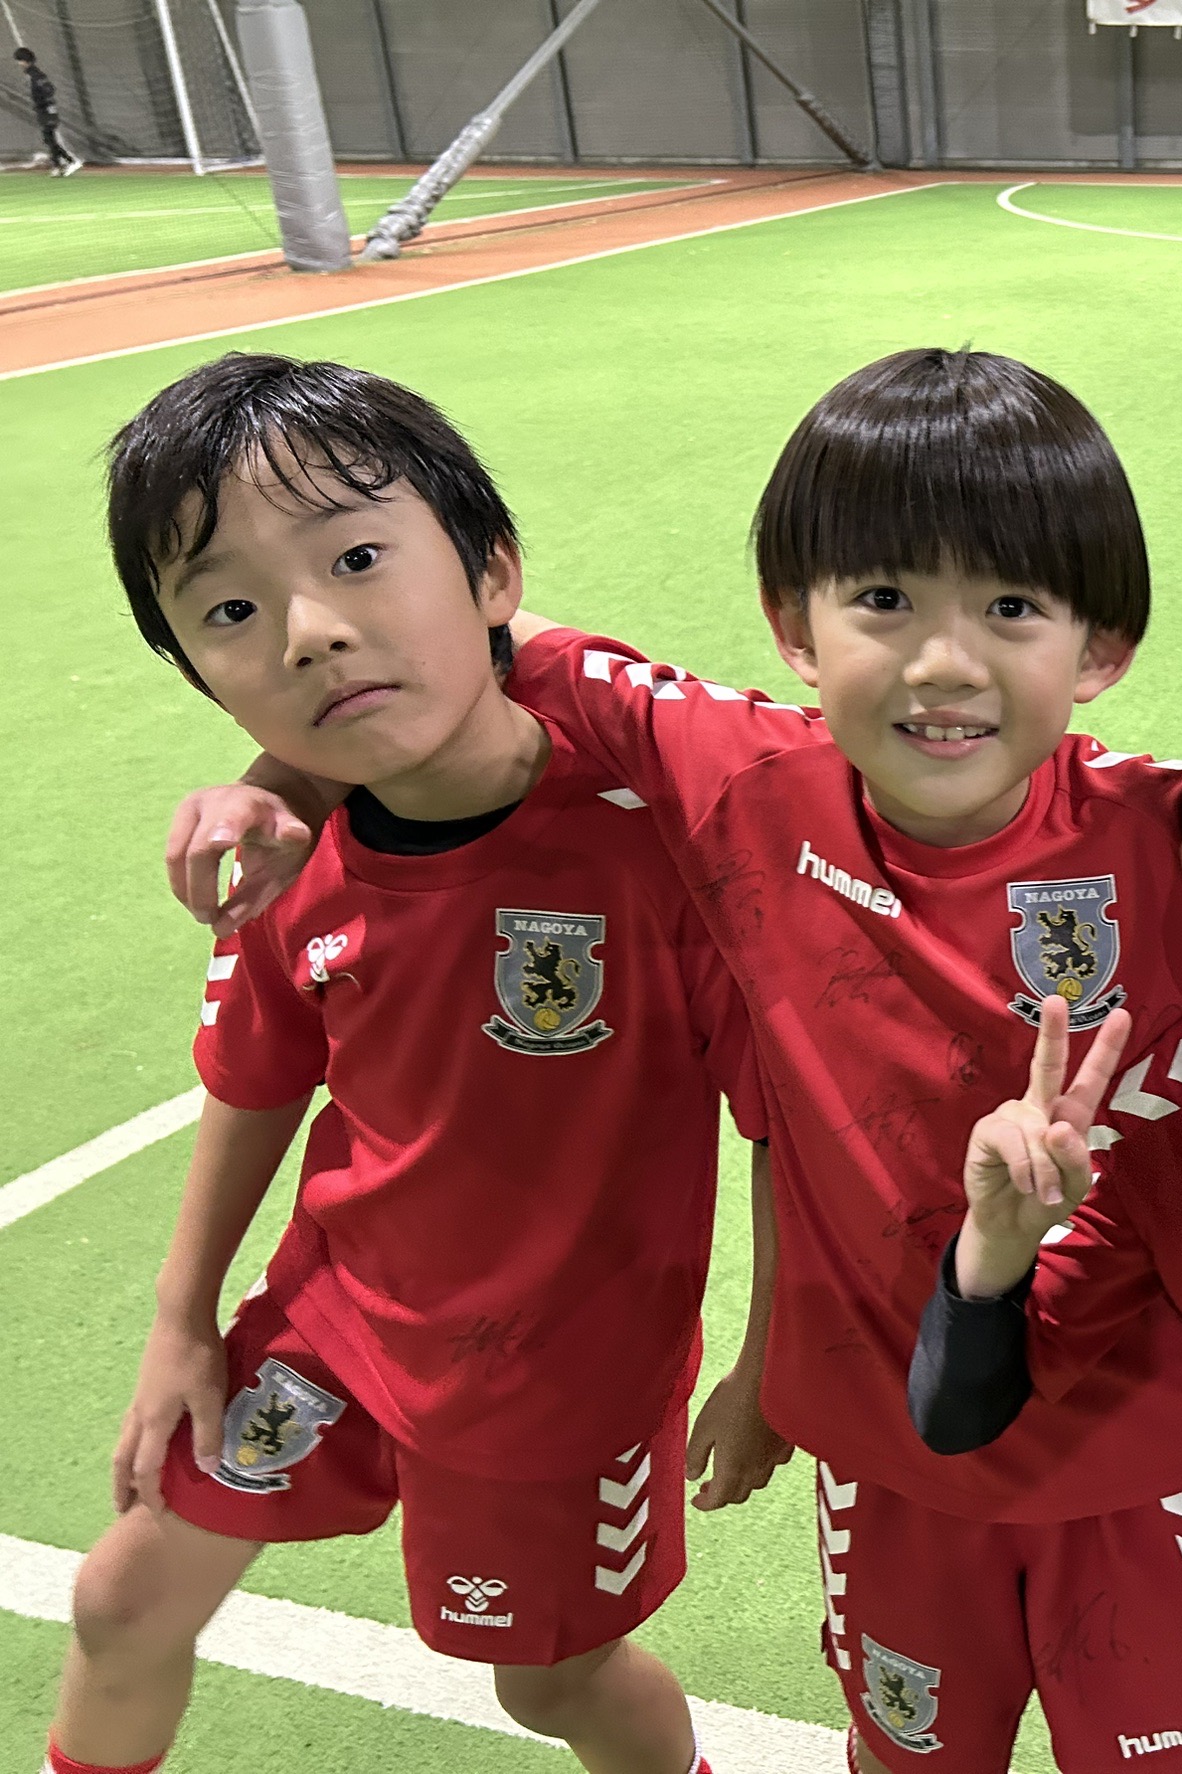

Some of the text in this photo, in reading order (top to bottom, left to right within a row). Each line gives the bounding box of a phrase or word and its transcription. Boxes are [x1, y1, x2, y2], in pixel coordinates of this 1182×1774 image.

[797, 840, 902, 919] hummel
[1025, 887, 1100, 904] NAGOYA
[514, 919, 588, 937] NAGOYA
[440, 1605, 514, 1628] hummel
